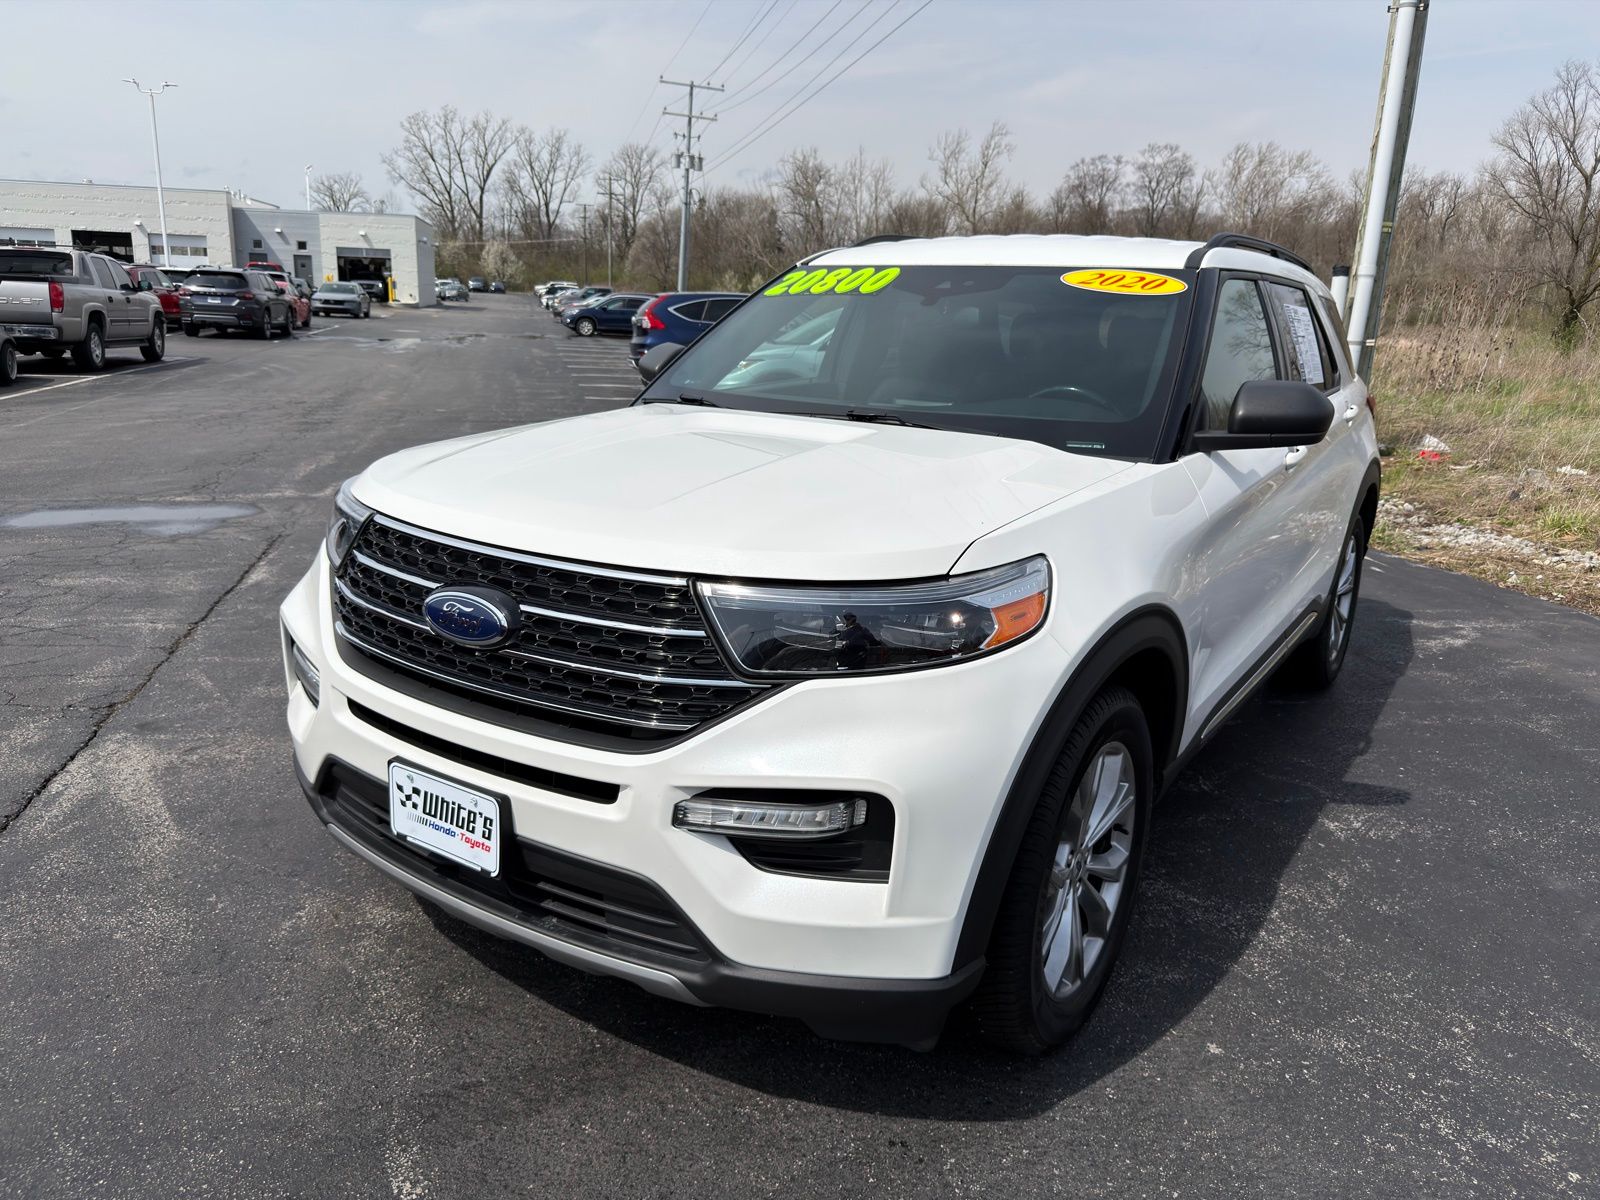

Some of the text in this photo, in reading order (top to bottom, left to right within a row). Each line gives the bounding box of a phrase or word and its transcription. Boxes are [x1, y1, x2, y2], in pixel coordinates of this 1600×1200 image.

[763, 267, 900, 296] 20800
[1077, 273, 1168, 290] 2020
[439, 601, 483, 635] Ford
